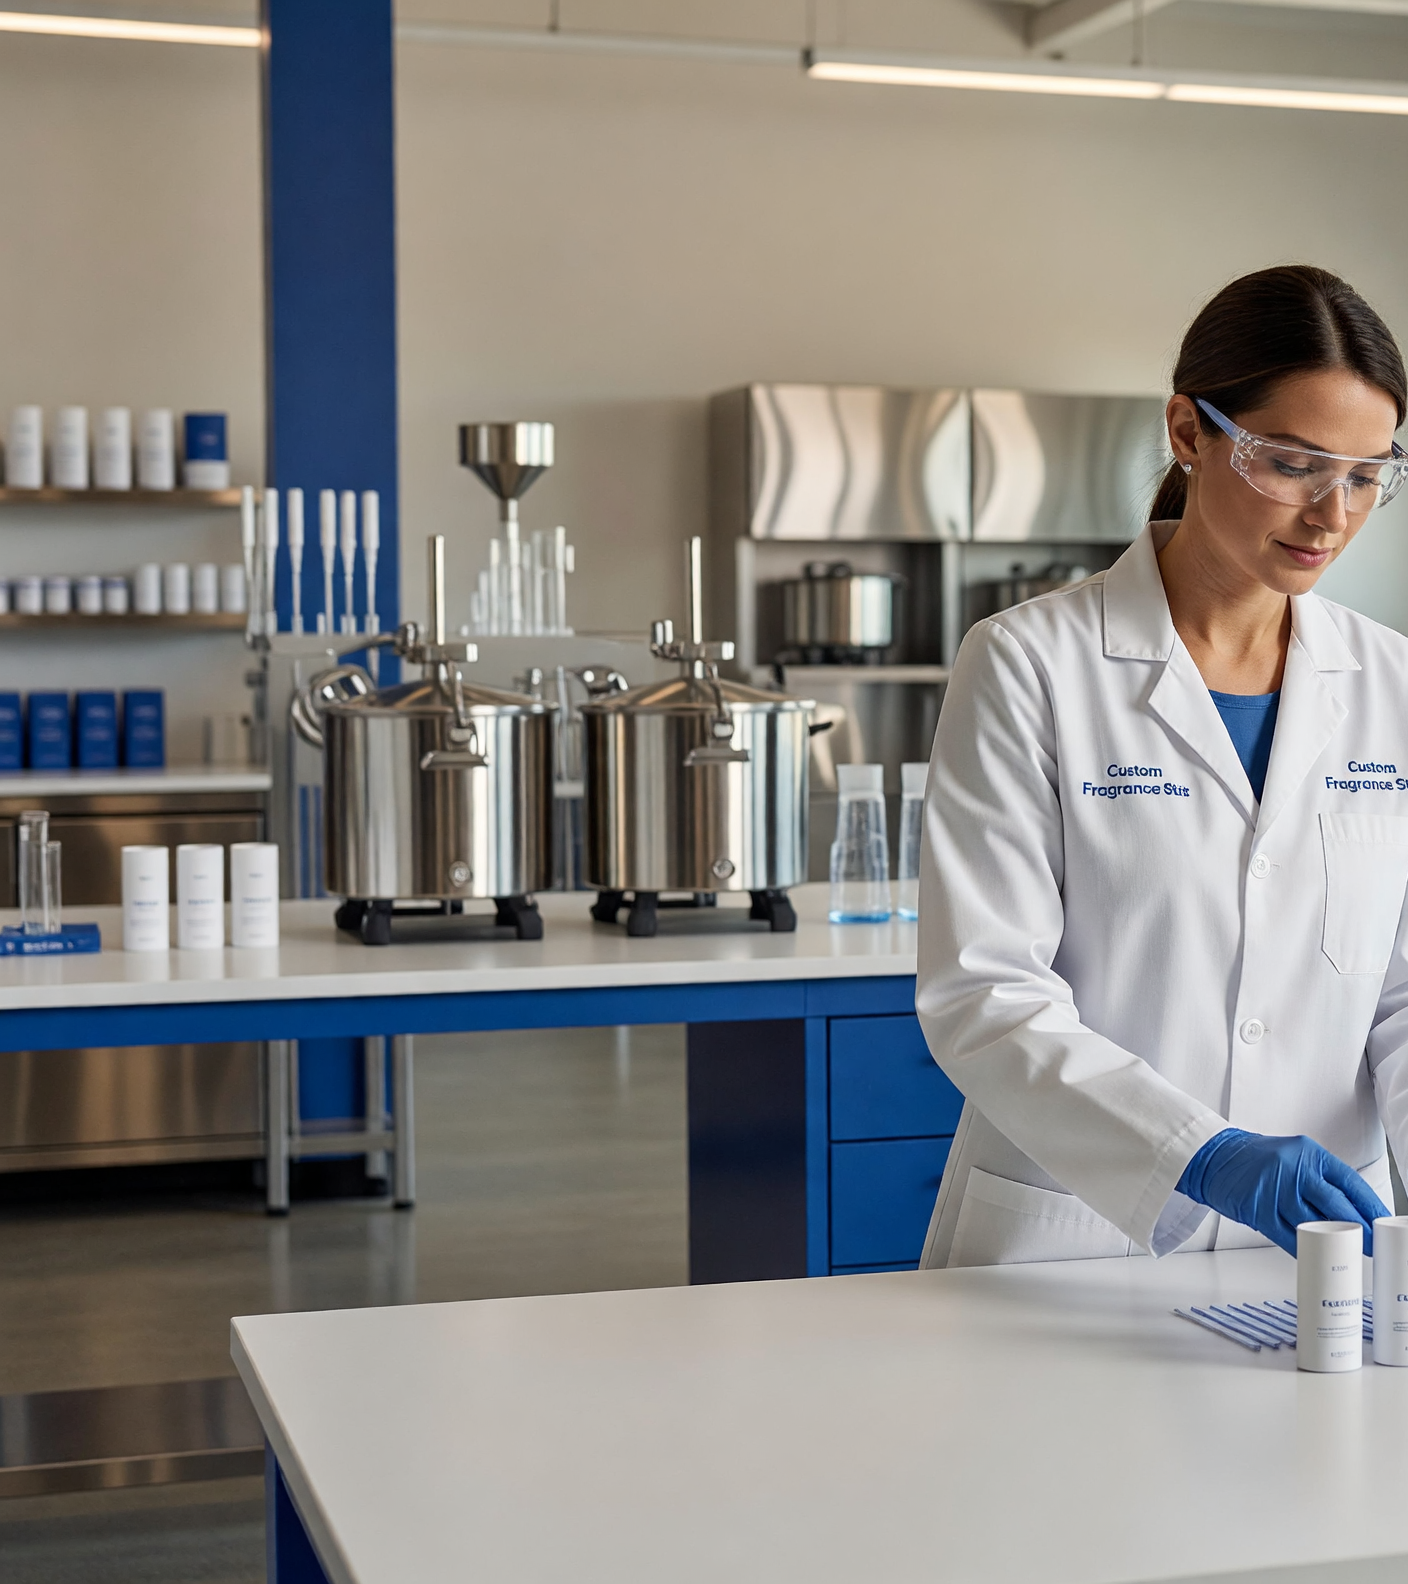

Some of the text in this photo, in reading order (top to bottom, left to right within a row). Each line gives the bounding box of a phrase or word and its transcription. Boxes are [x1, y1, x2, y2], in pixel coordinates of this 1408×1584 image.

[1107, 764, 1163, 778] Custom
[1347, 760, 1397, 774] Custom
[1082, 781, 1161, 799] Fragrance
